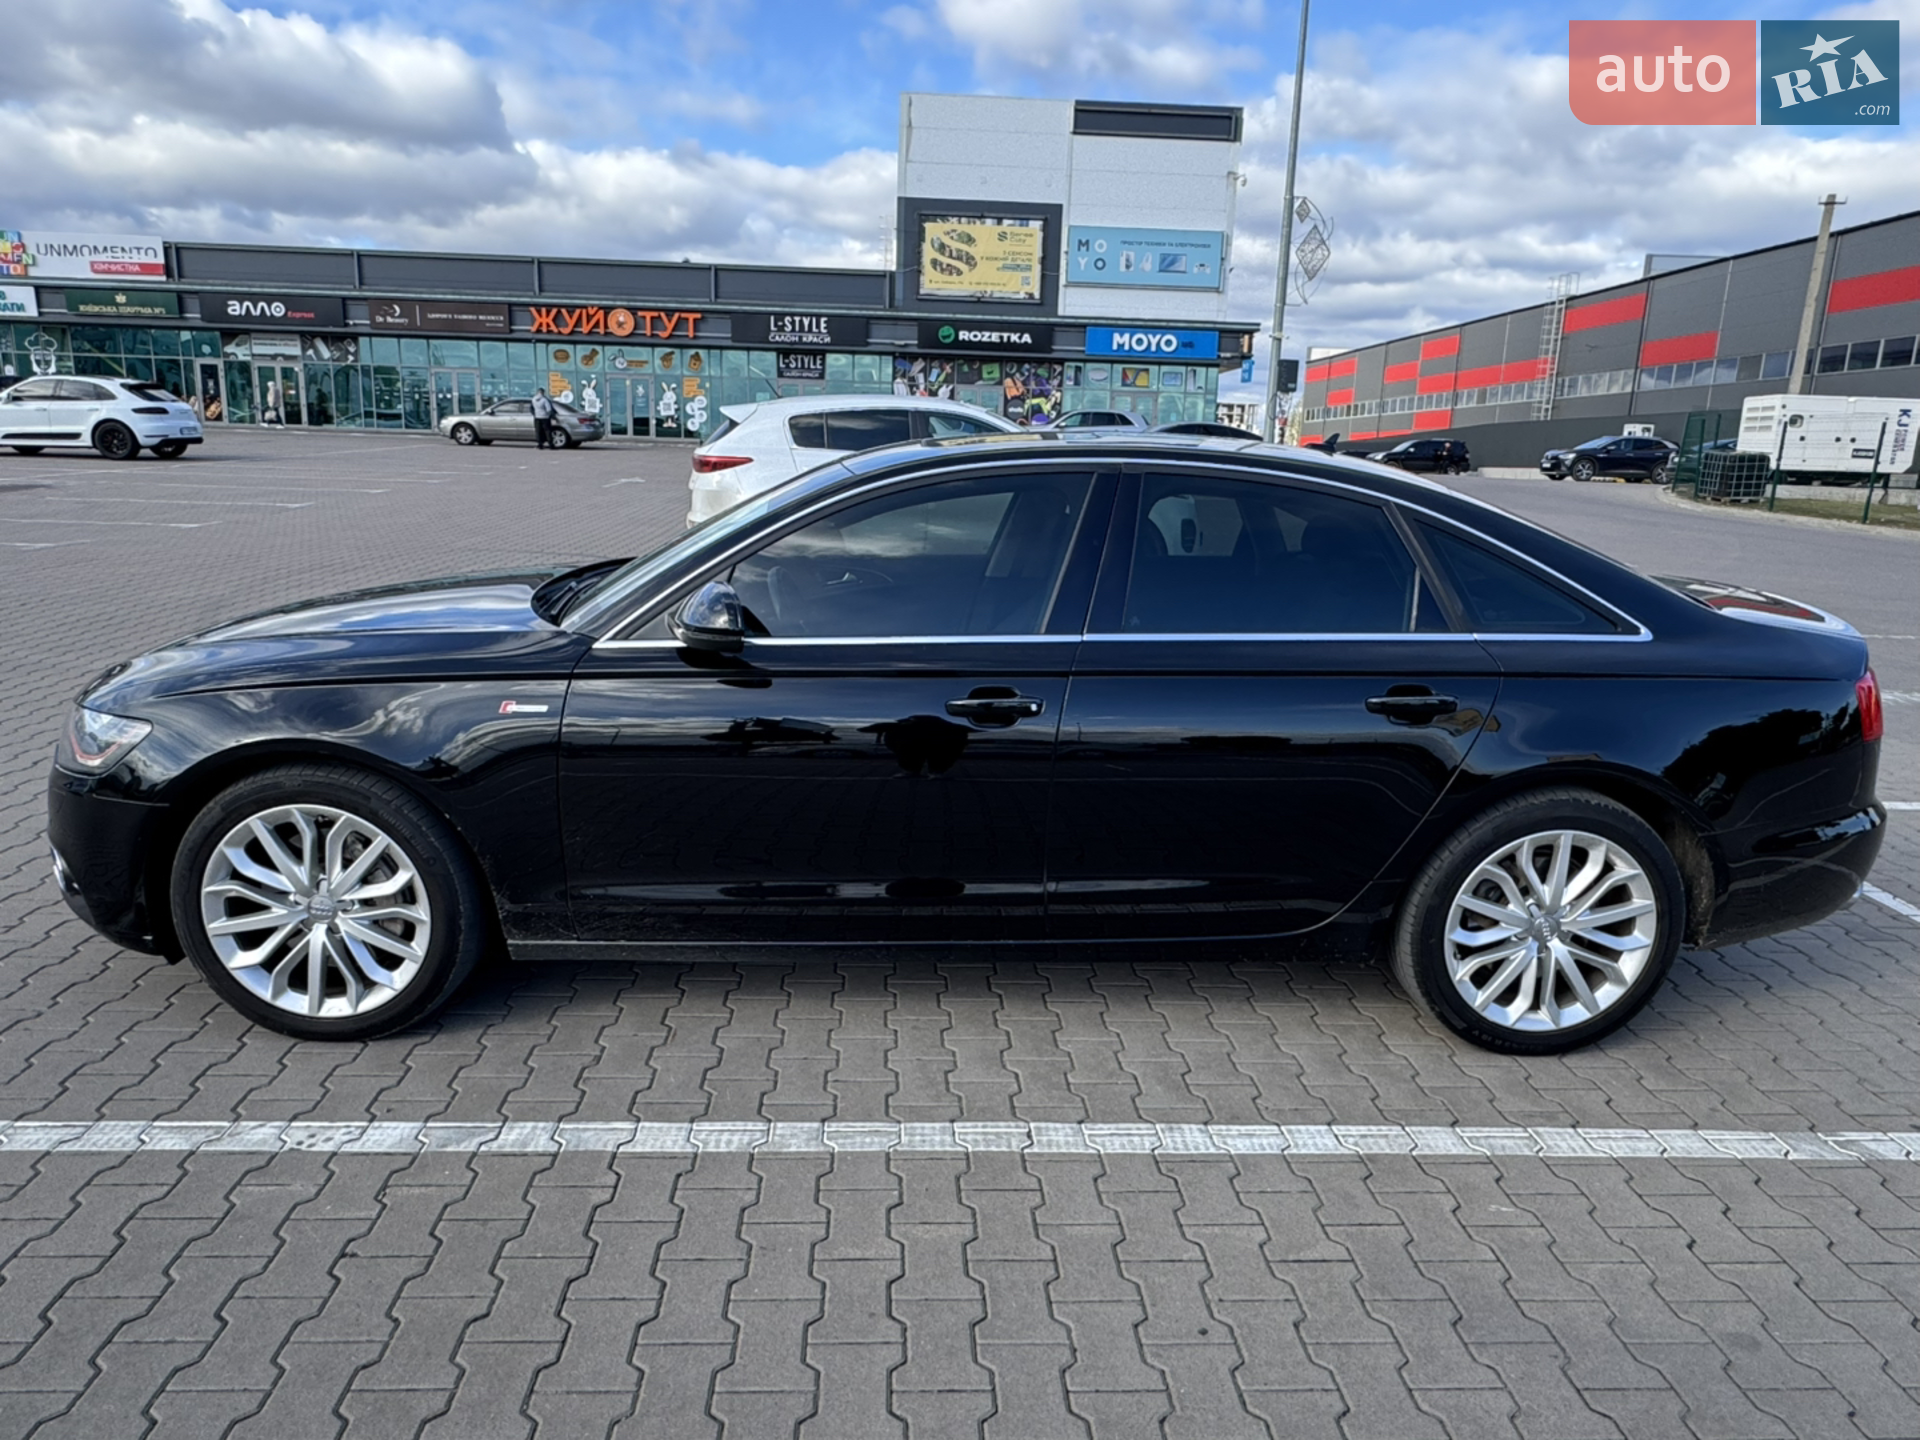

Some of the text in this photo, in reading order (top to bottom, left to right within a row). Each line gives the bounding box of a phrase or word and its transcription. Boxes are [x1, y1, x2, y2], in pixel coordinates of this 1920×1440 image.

[36, 243, 158, 260] UNMOMENTO
[93, 262, 141, 273] ХІМЧИСТКА
[530, 306, 605, 335] ЖУЙ
[637, 310, 702, 339] ТУТ
[770, 315, 828, 333] L-STYLE
[769, 333, 831, 343] САЛОН КРАСИ
[958, 330, 1033, 344] ROZETKA
[1111, 332, 1178, 352] MOYO
[779, 354, 823, 369] L-STYLE
